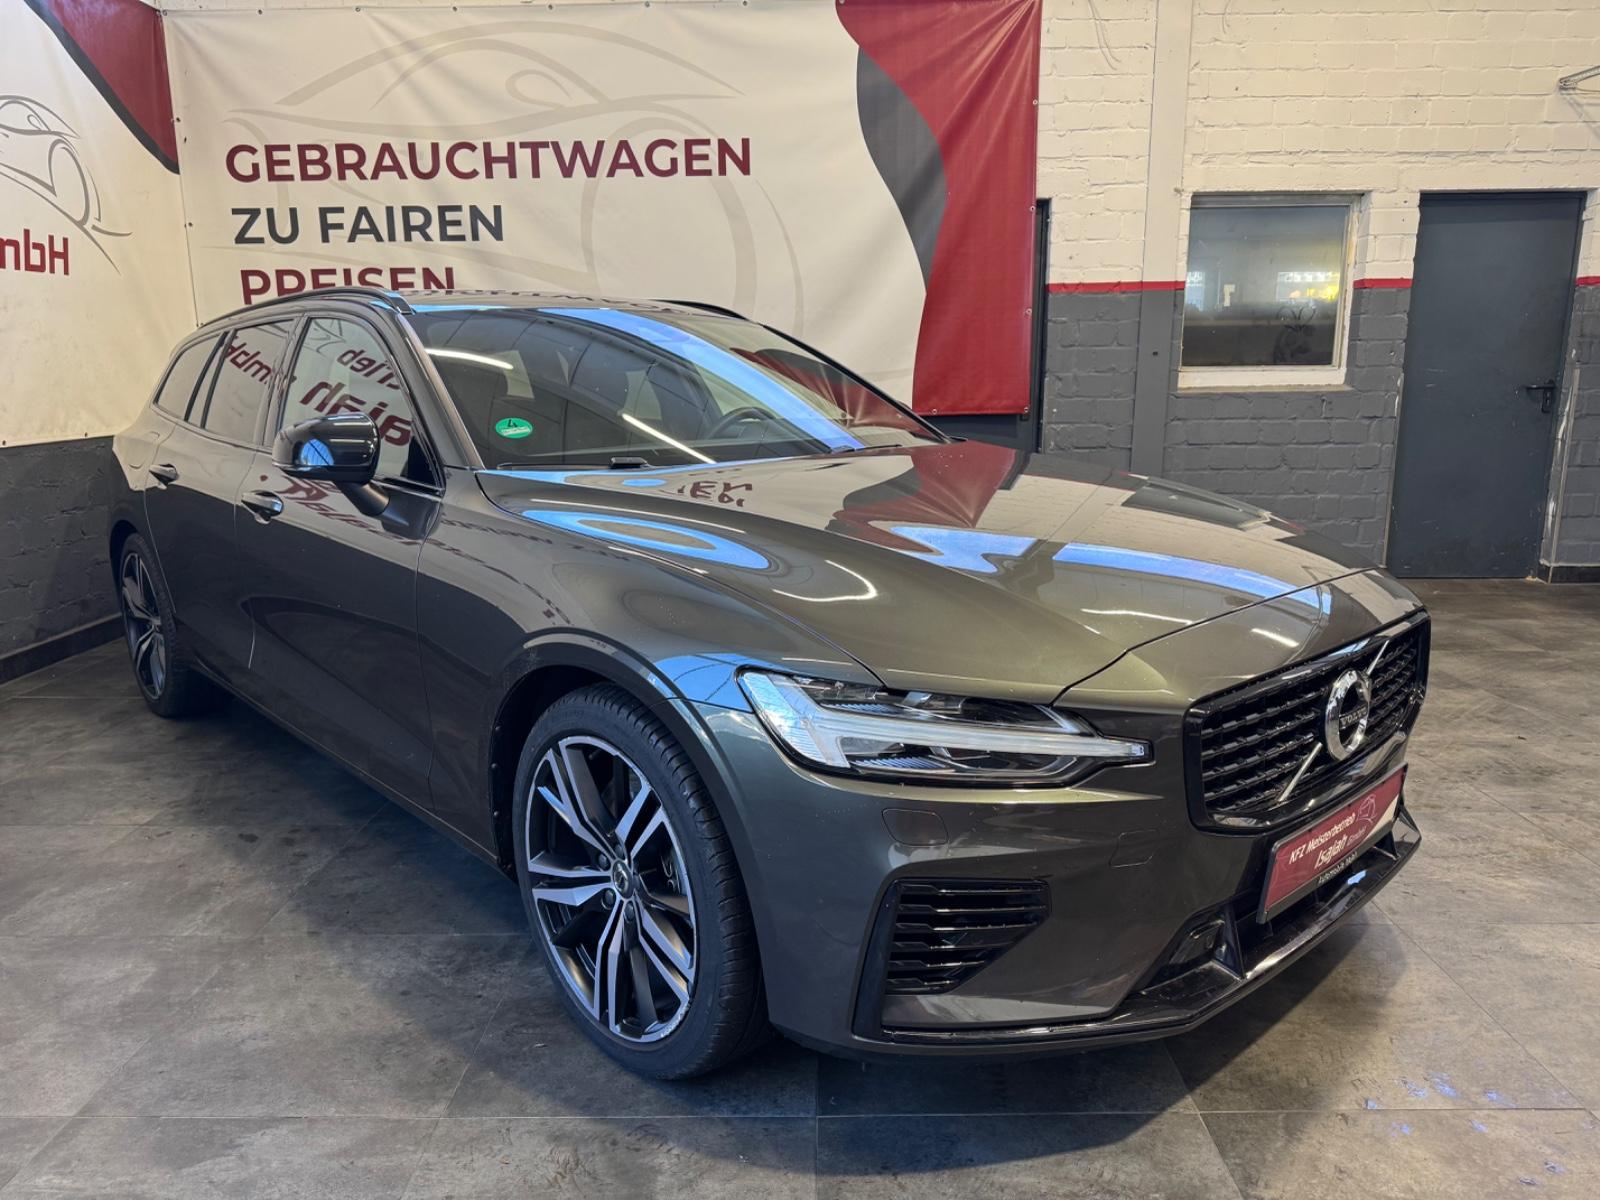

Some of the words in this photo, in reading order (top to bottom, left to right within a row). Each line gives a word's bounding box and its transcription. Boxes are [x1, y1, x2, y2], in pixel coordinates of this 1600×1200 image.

[226, 138, 751, 182] GEBRAUCHTWAGEN
[231, 207, 300, 245] ZU
[318, 205, 504, 243] FAIREN
[1289, 843, 1307, 865] KFZ
